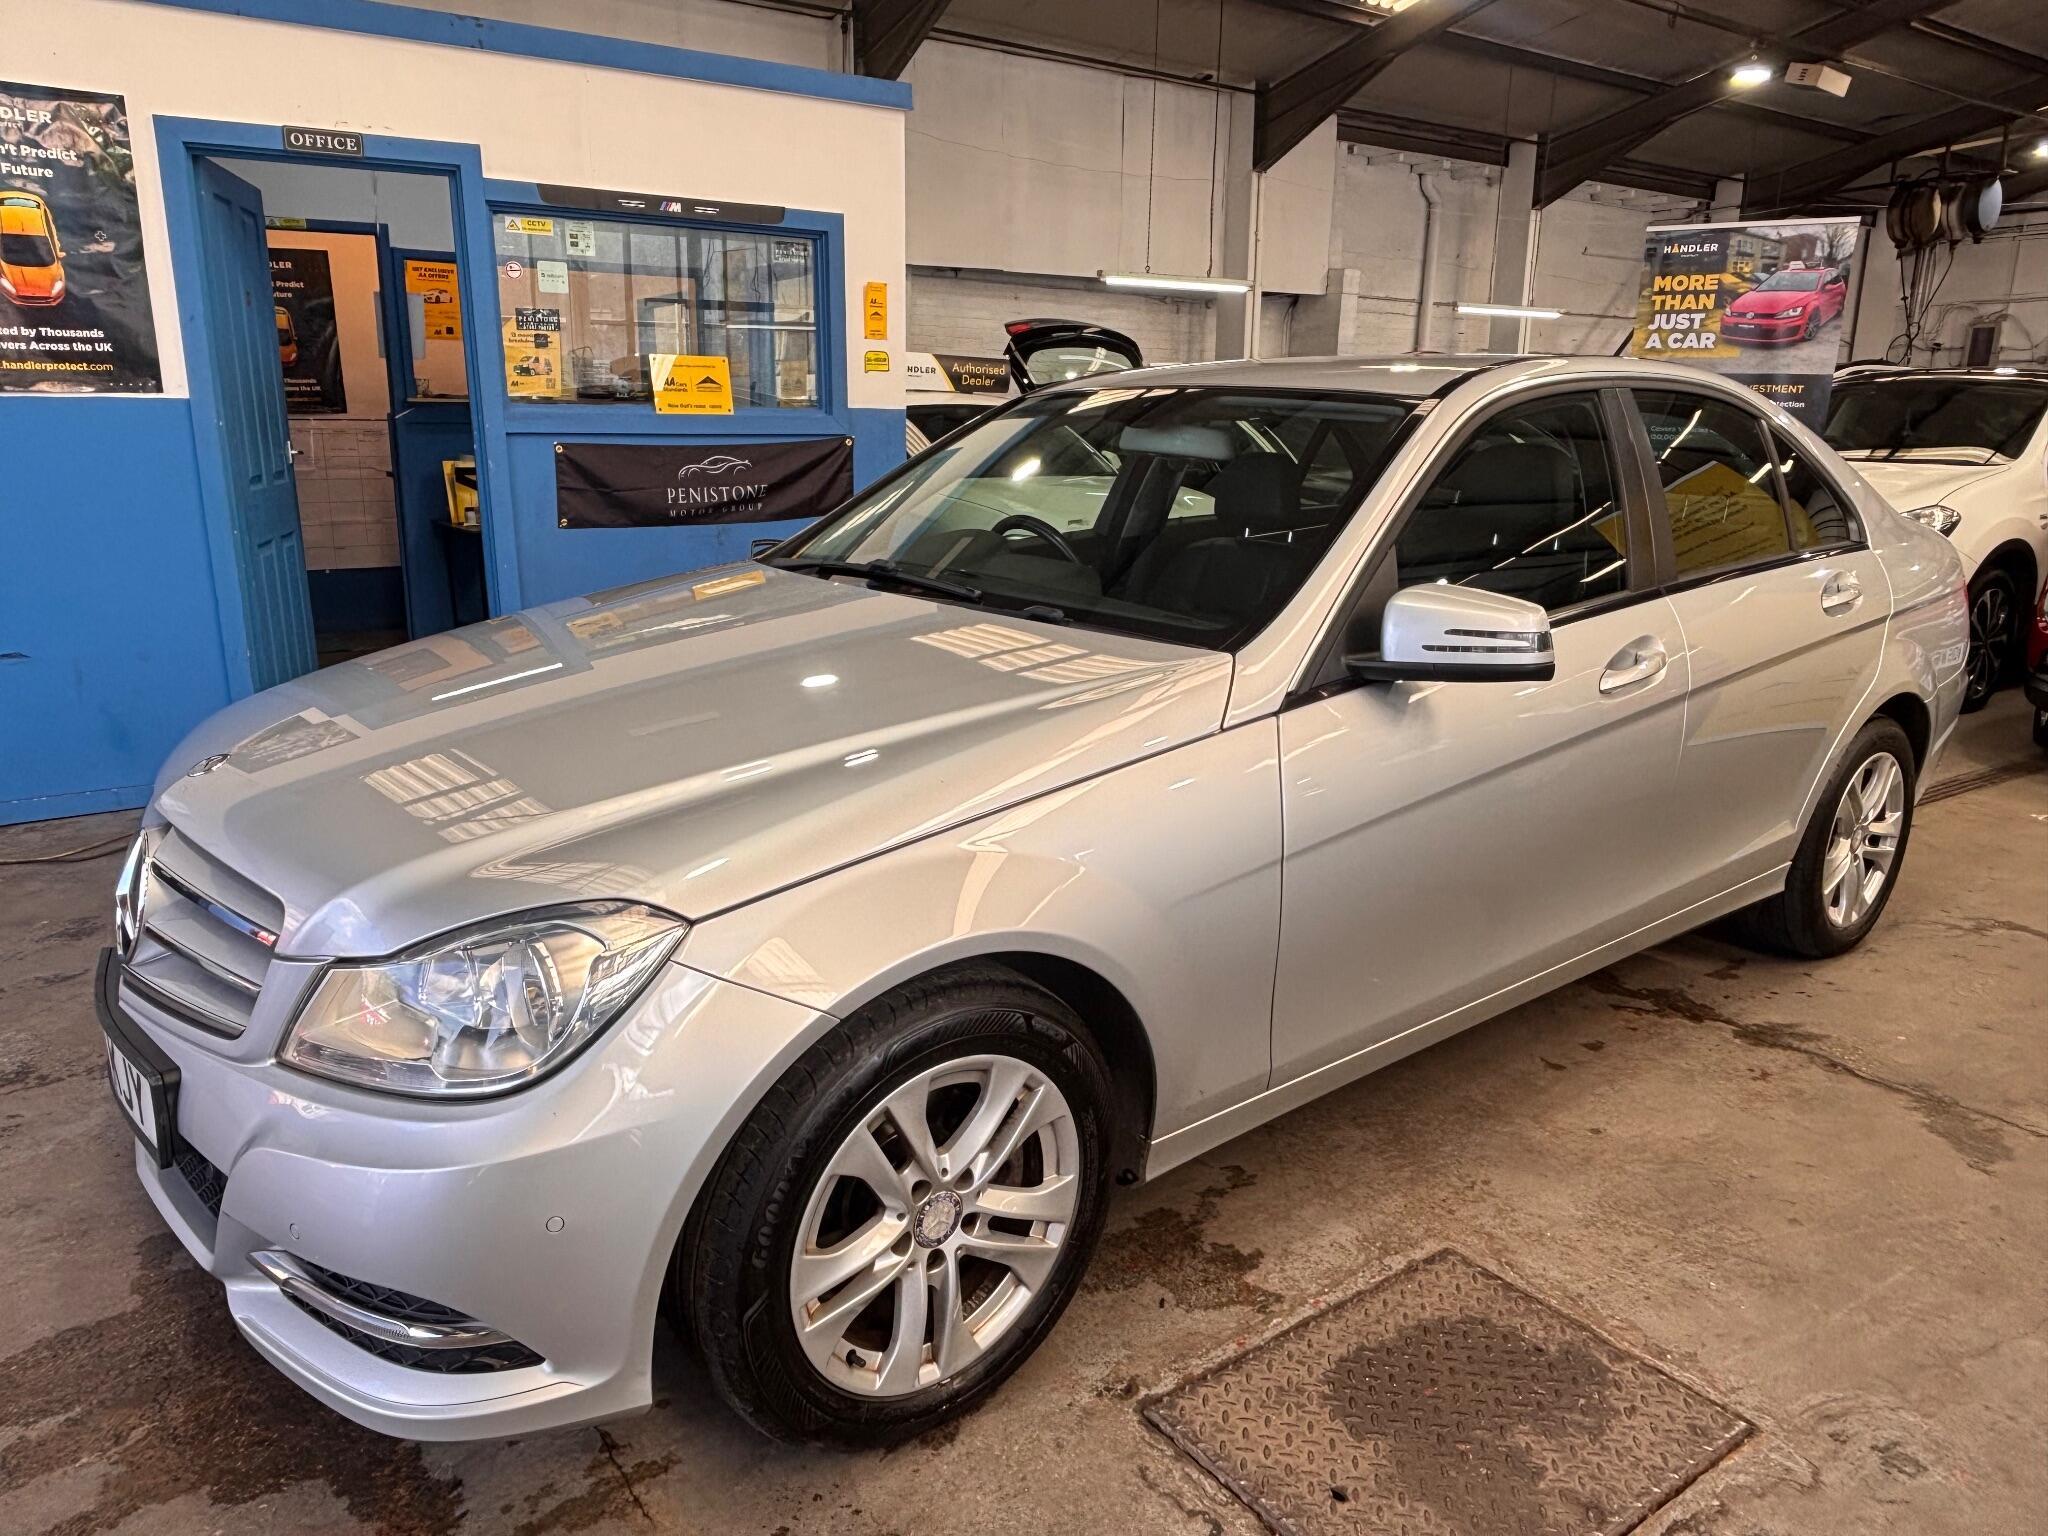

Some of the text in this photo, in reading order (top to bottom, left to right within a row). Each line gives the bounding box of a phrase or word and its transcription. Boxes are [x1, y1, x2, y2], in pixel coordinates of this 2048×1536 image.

[290, 132, 357, 151] OFFICE
[20, 145, 78, 160] Predict
[1, 162, 54, 177] Future
[1663, 243, 1719, 254] HANDLER
[1653, 273, 1720, 292] MORE
[1651, 293, 1716, 311] THAN
[1647, 312, 1706, 330] JUST
[20, 326, 37, 338] by
[39, 327, 105, 338] Thousands
[0, 341, 114, 352] vers Across the UK
[1644, 332, 1716, 349] A CAR
[952, 361, 1006, 376] Authorised
[663, 376, 676, 387] AA
[961, 374, 996, 387] Dealer
[667, 484, 769, 504] PENISTONE
[722, 502, 763, 513] GROUP
